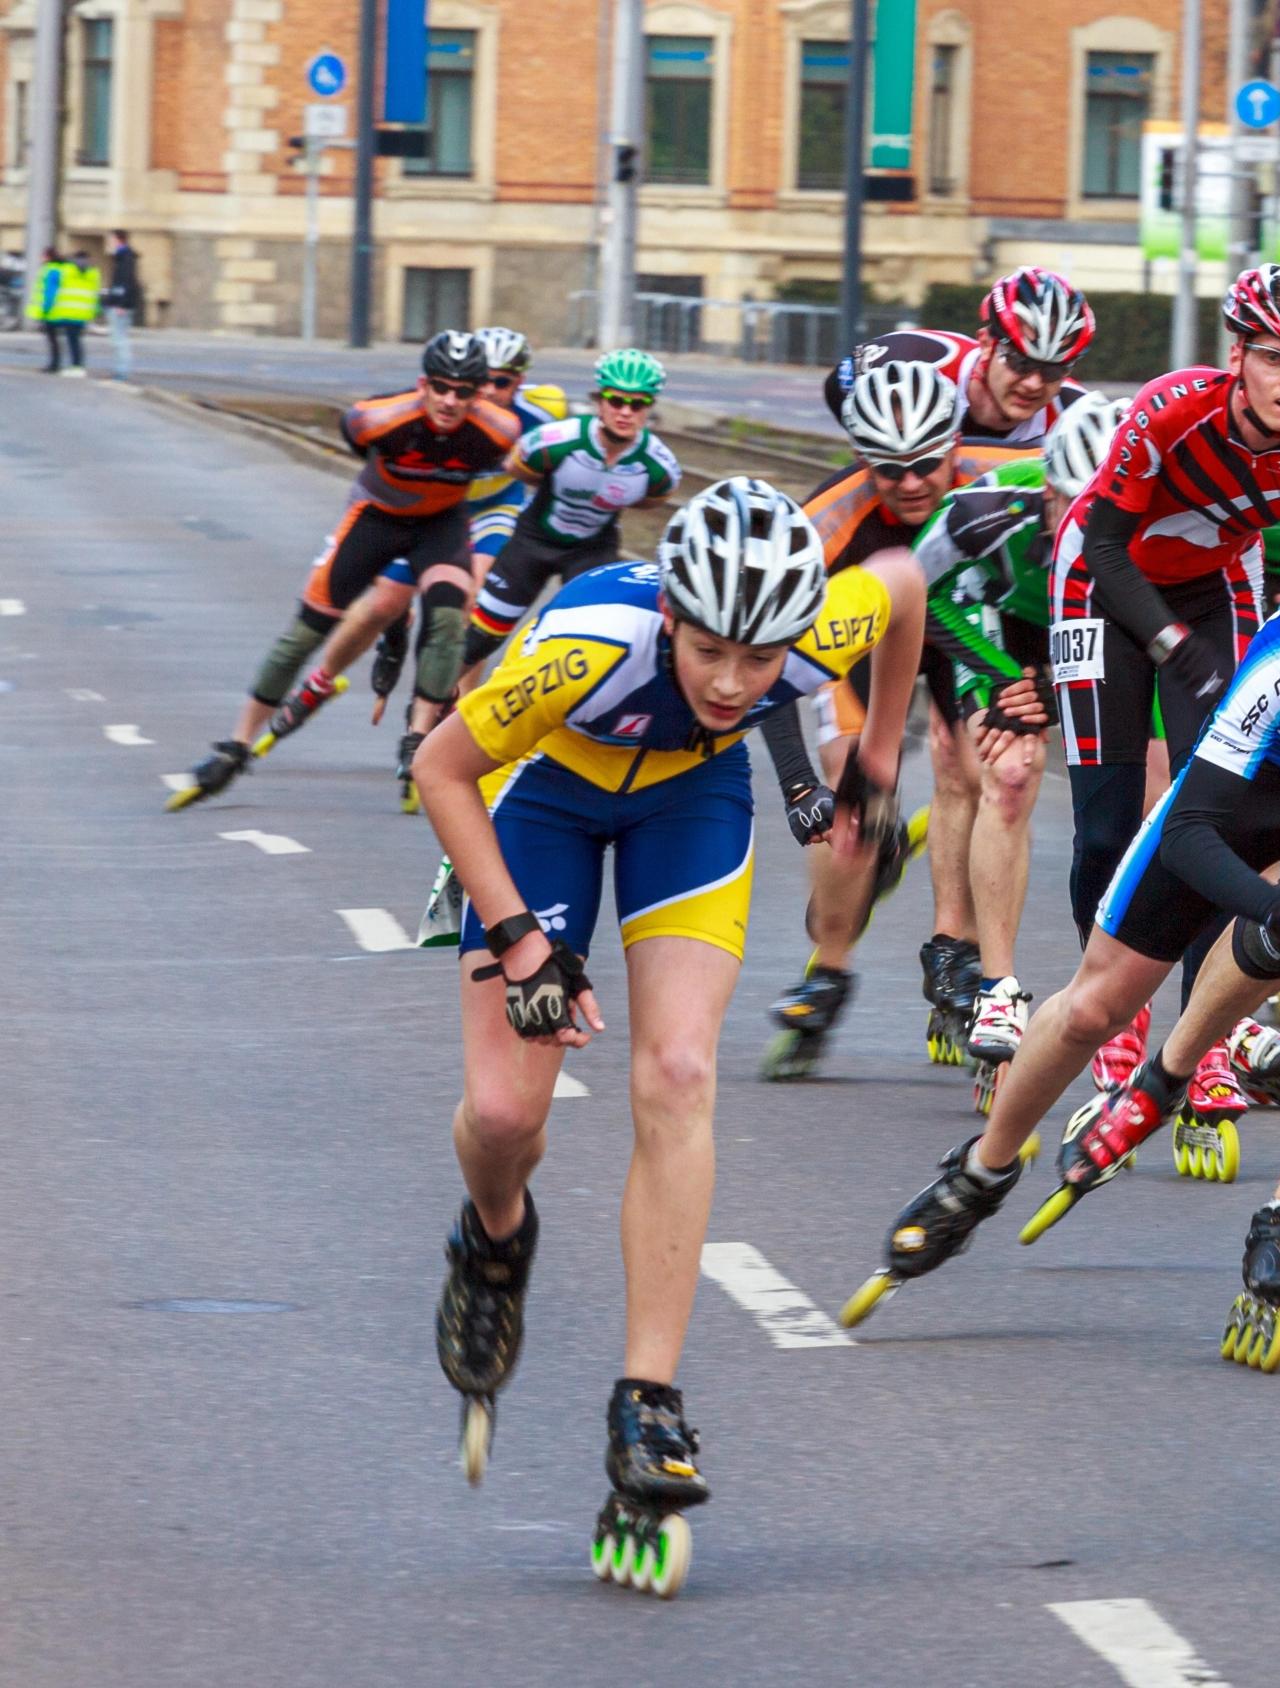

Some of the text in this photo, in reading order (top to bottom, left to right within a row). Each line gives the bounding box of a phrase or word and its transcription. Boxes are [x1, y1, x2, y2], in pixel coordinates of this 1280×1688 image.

[812, 611, 880, 651] LEIPZ
[1052, 627, 1098, 665] 0037
[490, 648, 589, 729] LEIPZIG
[1240, 693, 1269, 737] SSC
